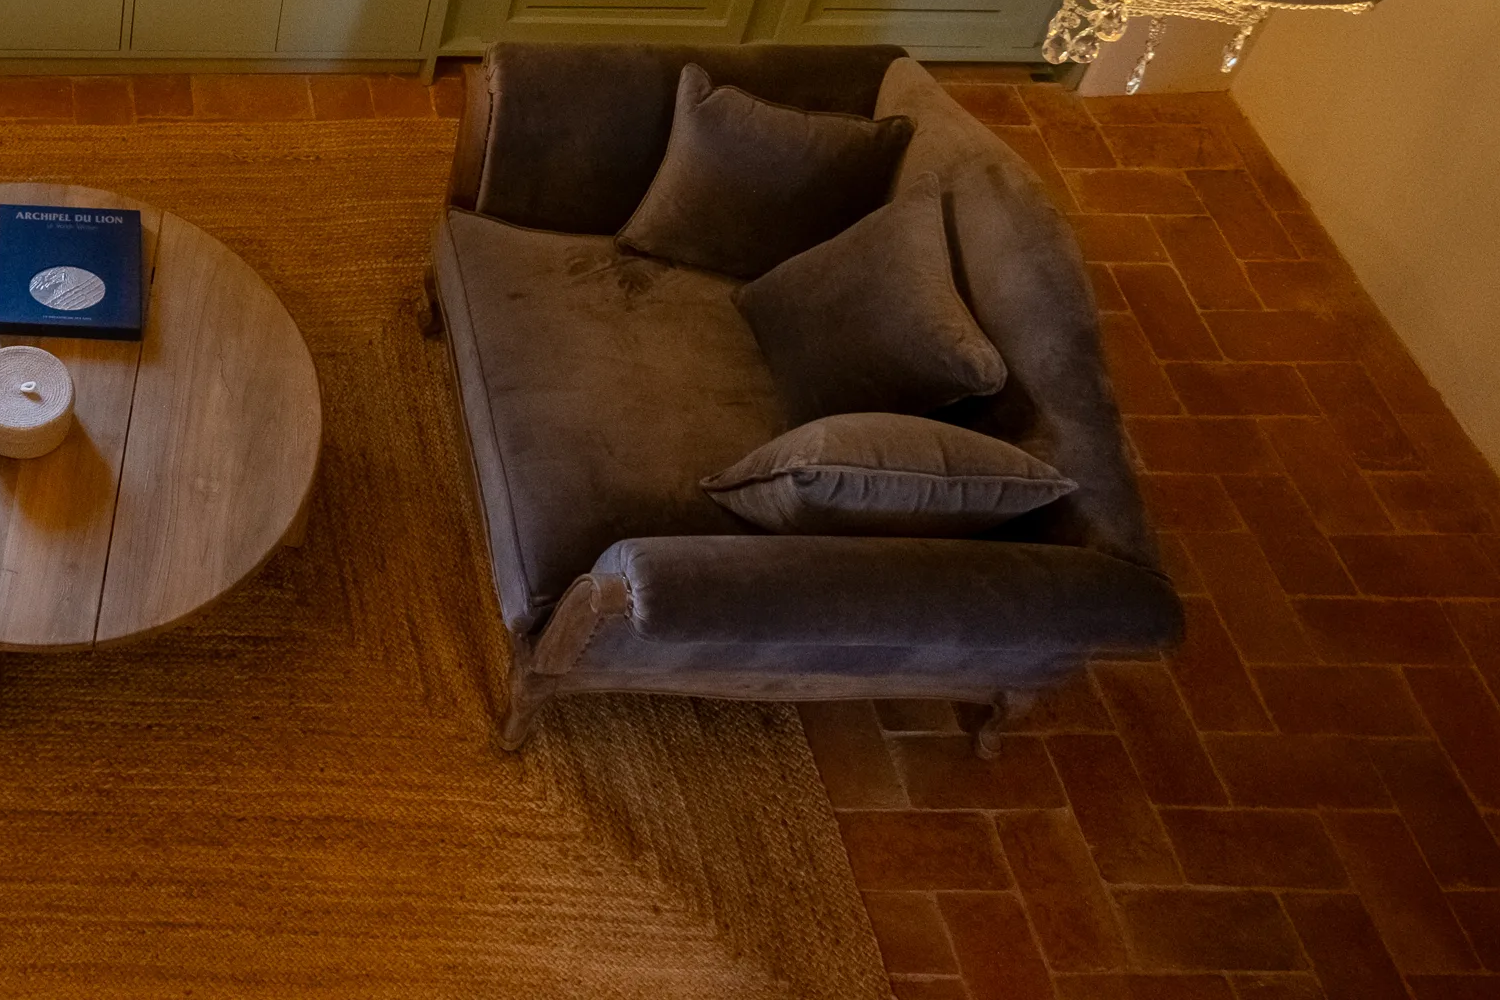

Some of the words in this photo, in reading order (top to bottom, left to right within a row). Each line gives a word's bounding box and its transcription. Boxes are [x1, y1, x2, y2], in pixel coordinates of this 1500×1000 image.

[16, 211, 71, 222] ARCHIPEL
[74, 214, 91, 223] DU
[95, 215, 123, 224] LION
